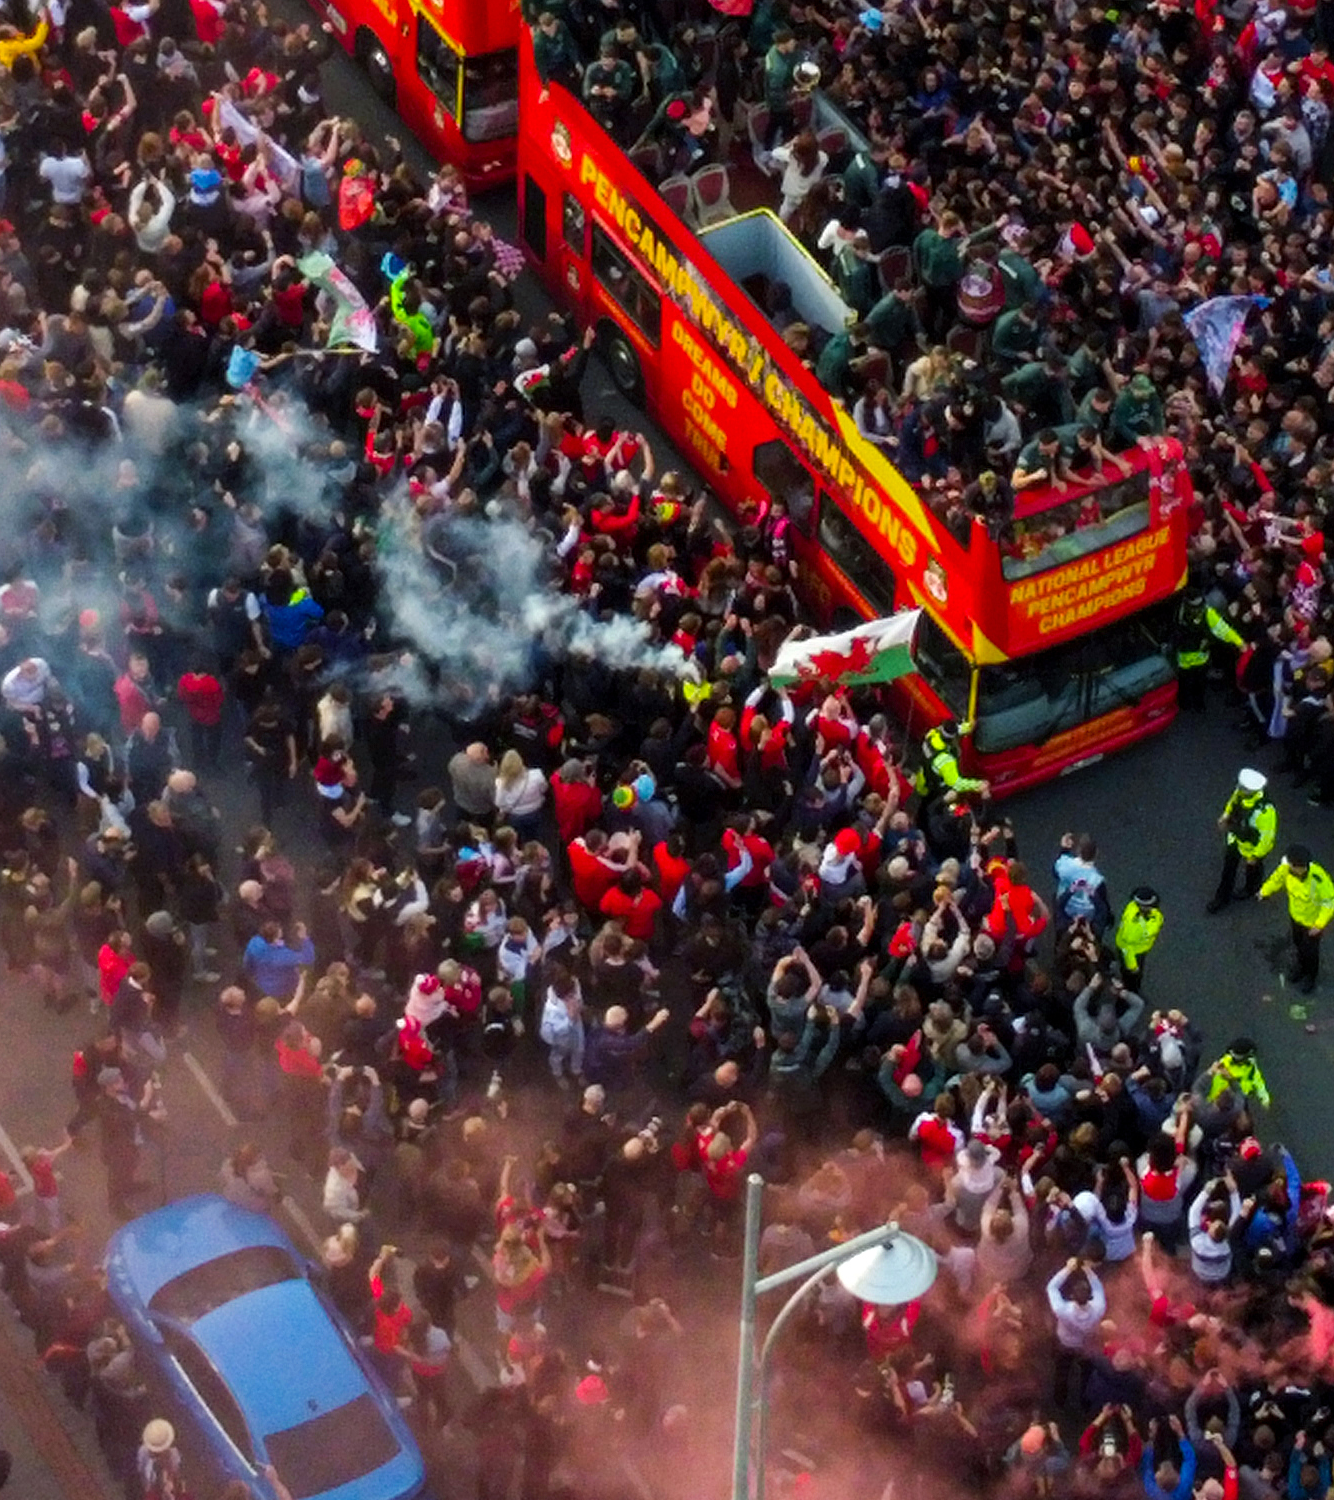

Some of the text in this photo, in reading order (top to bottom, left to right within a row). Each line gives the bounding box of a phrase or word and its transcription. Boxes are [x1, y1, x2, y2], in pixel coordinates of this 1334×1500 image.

[580, 153, 749, 364] PENCAMPWYR
[765, 373, 917, 566] CHAMPIONS
[671, 319, 738, 408] DREAMS
[691, 371, 715, 409] DO
[682, 388, 727, 452] COME
[1010, 525, 1170, 605] NATIONAL LEAGUE
[1027, 553, 1156, 618] PENCAMPWYR
[1039, 577, 1147, 634] CHAMPIONS
